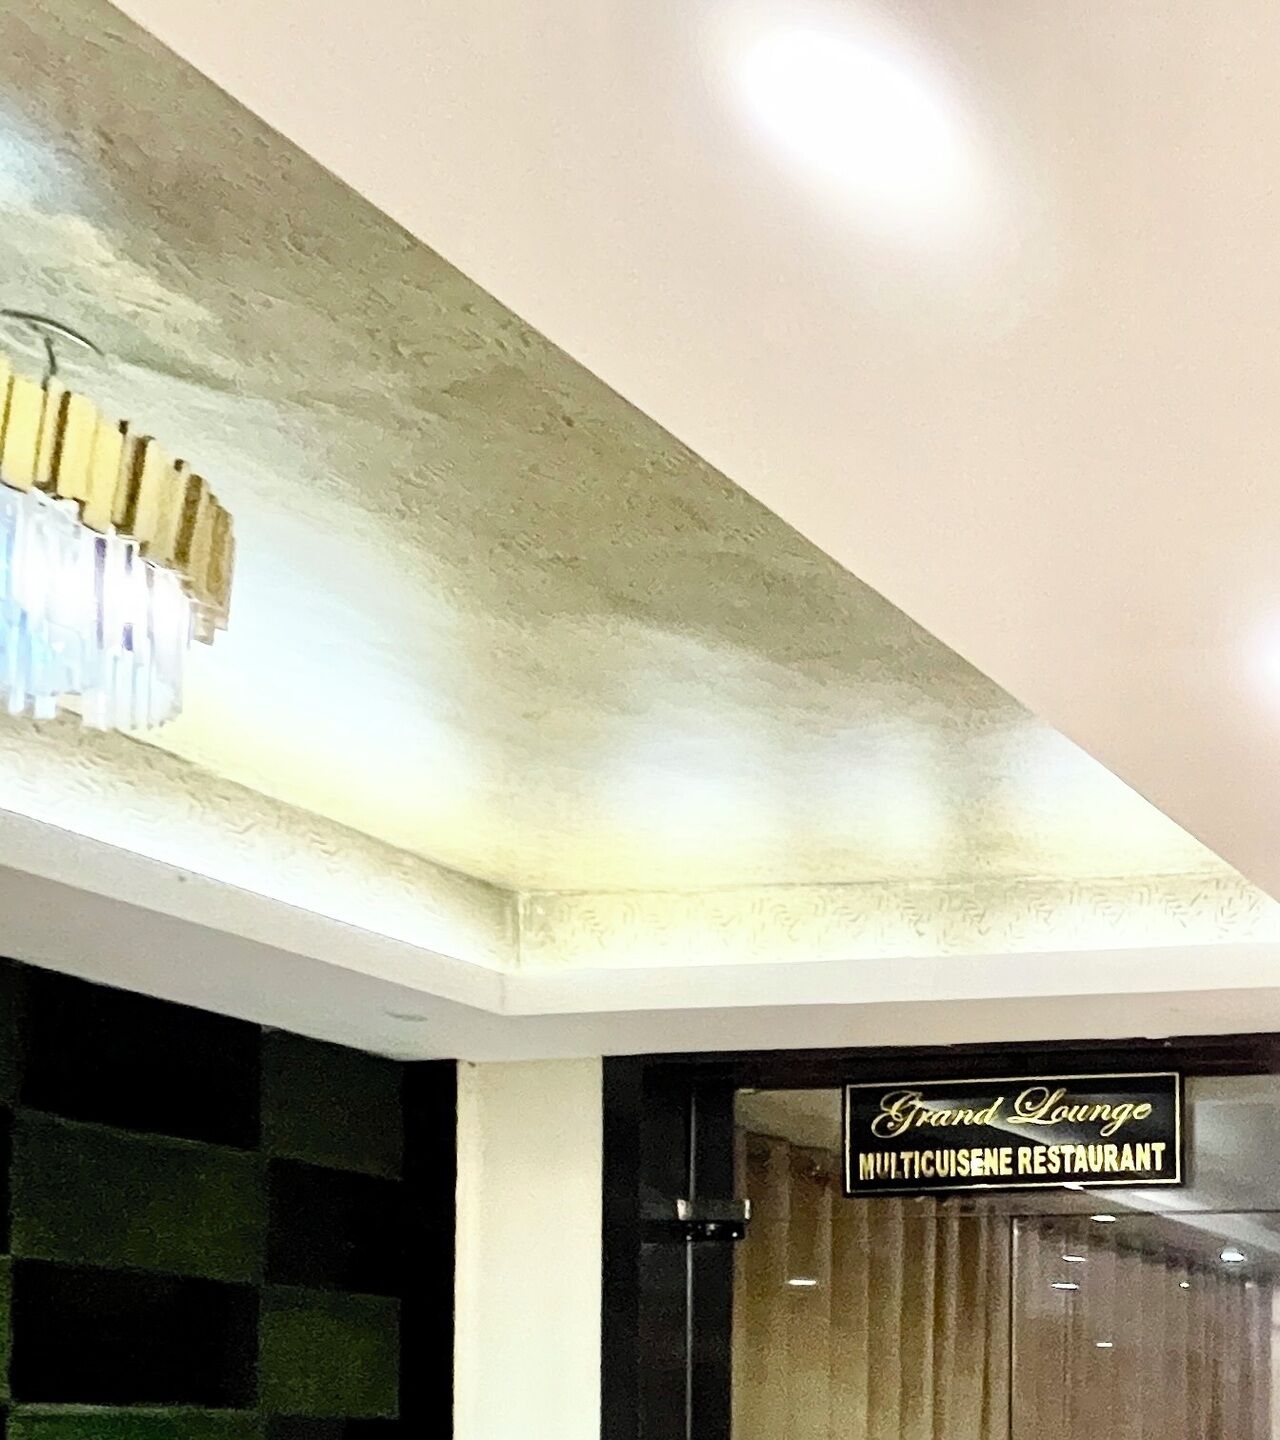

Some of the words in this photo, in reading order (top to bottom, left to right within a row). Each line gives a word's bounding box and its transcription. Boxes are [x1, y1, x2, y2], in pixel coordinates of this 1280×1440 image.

[871, 1090, 1004, 1139] Grand
[1006, 1086, 1153, 1136] Lounge
[859, 1146, 1013, 1181] MULTICUISENE
[1017, 1141, 1166, 1176] RESTAURANT
